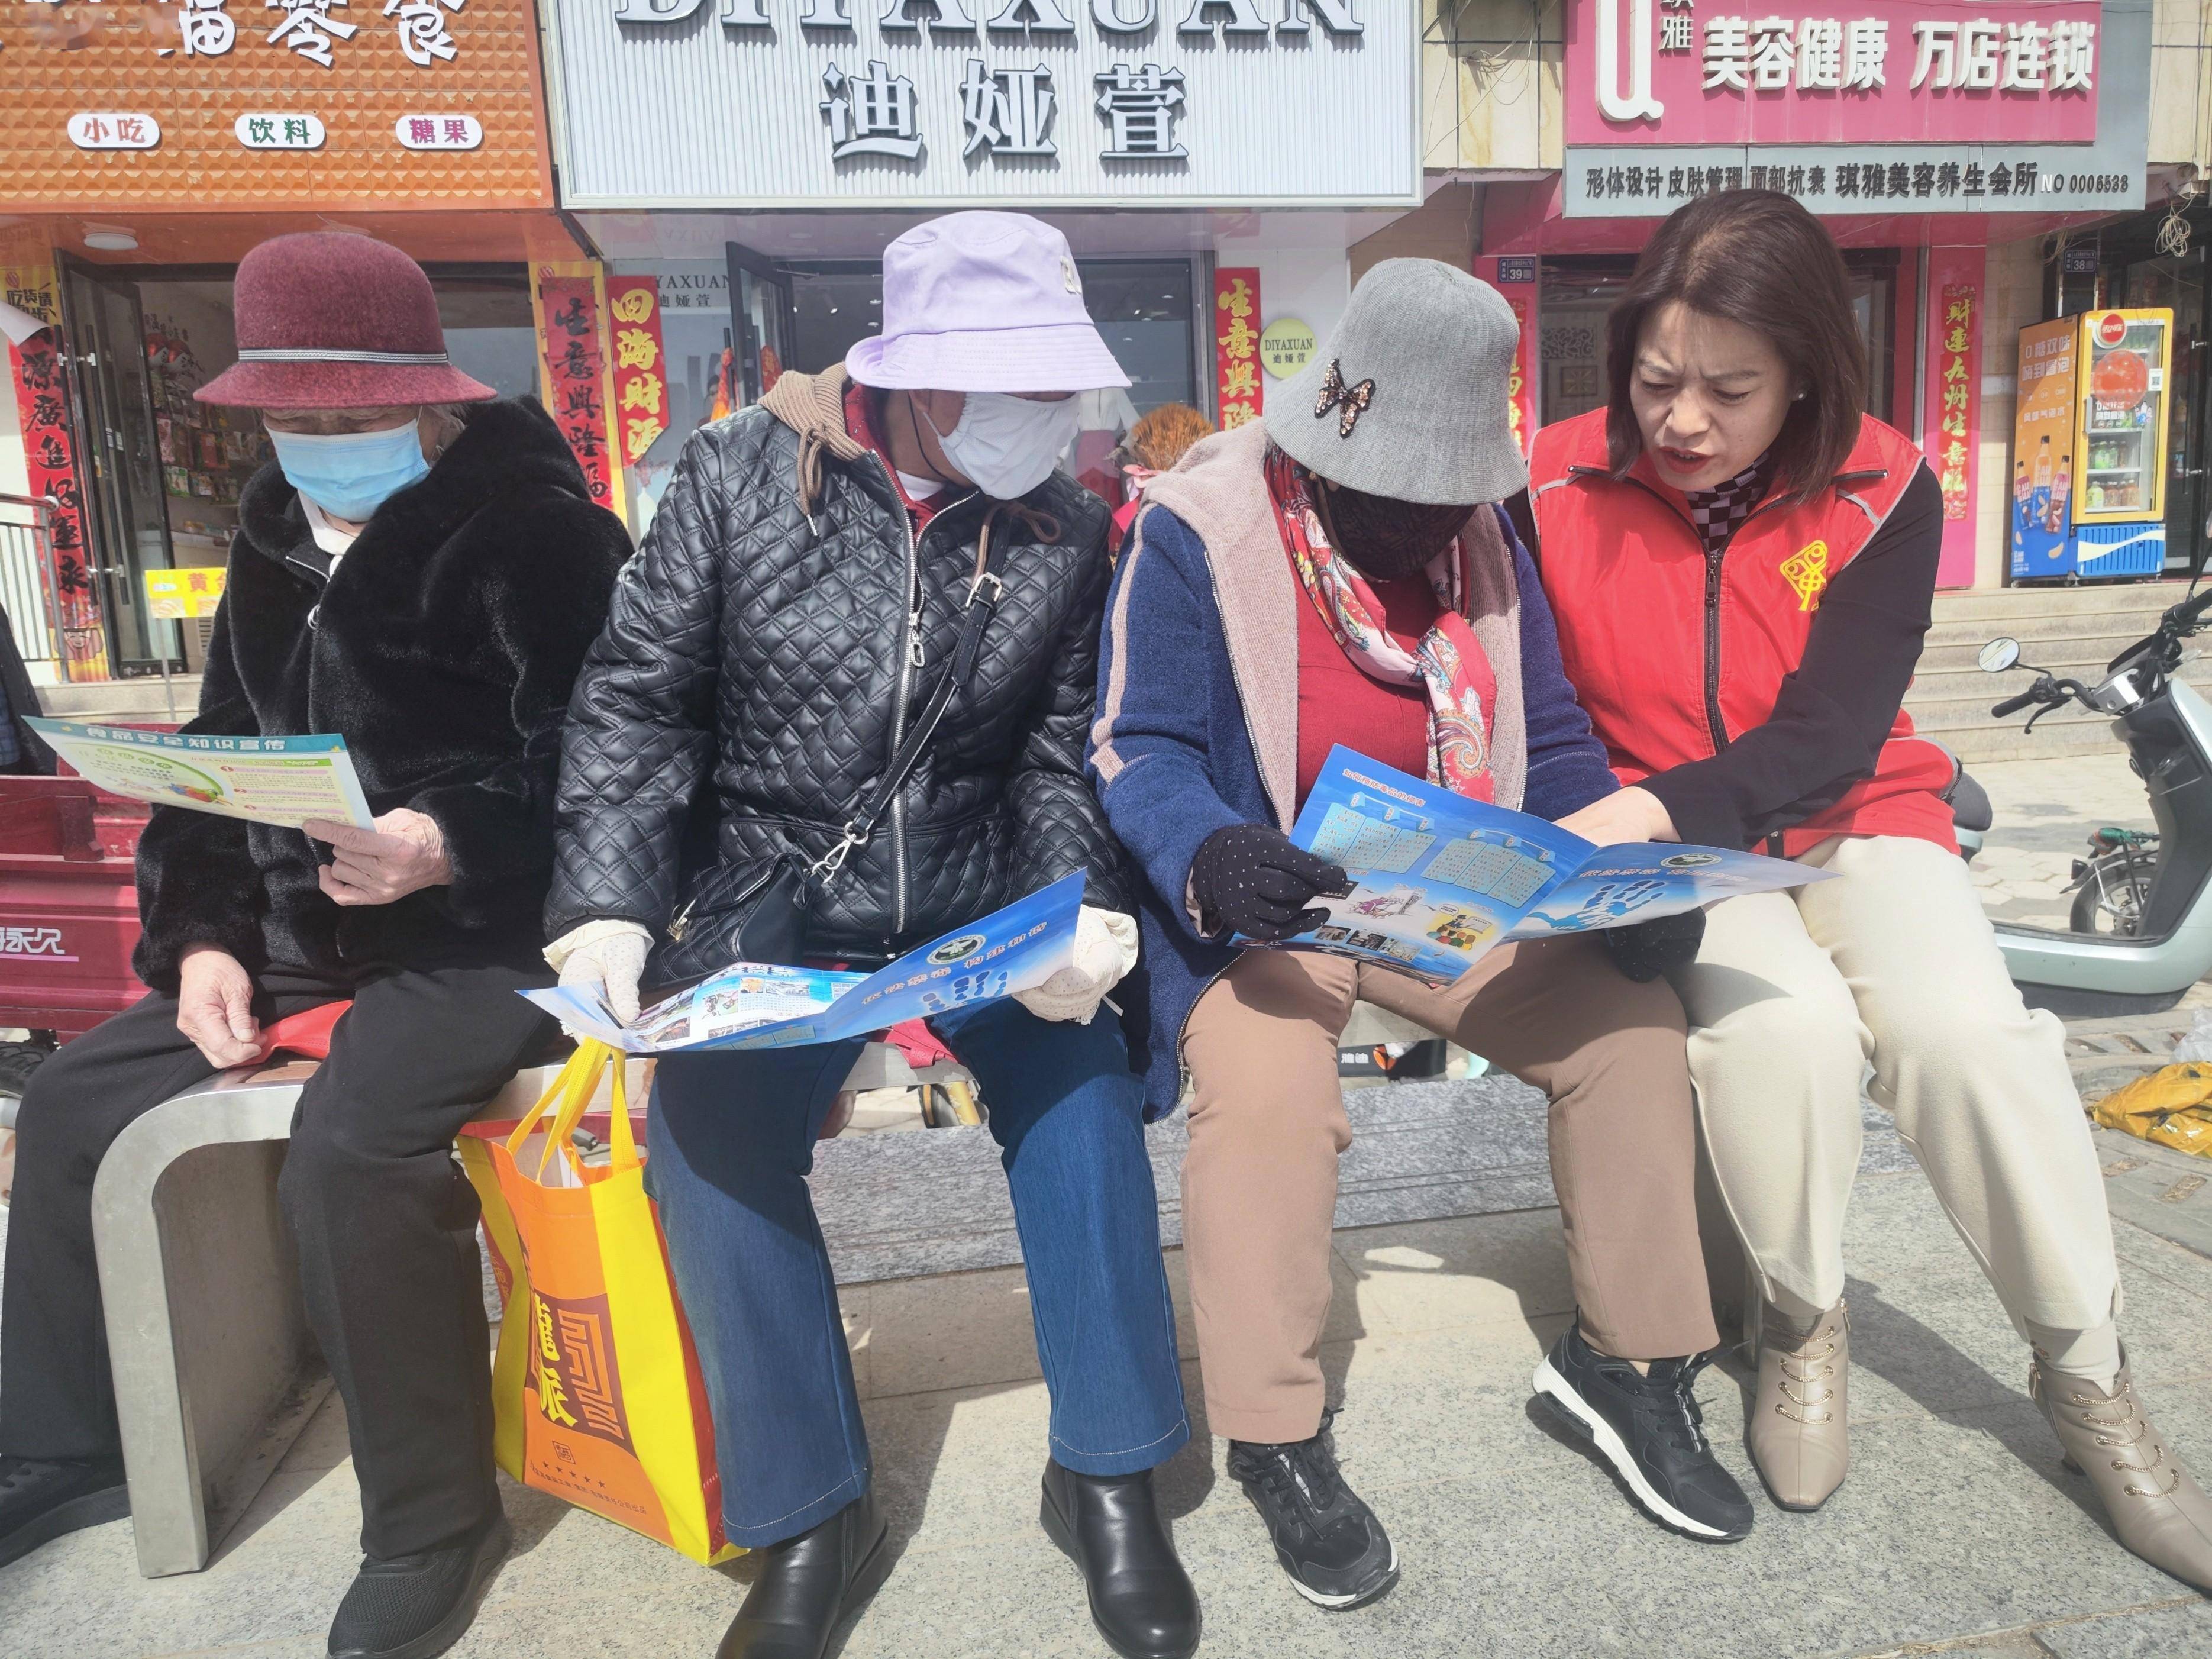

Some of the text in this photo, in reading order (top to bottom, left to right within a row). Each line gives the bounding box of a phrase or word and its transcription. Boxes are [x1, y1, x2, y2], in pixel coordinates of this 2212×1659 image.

[1701, 16, 2095, 92] 美容健康 万店连锁
[821, 59, 1189, 161] 迪娅萱
[83, 118, 146, 144] 小吃
[249, 118, 311, 144] 饮料
[409, 118, 469, 144] 糖果
[1585, 166, 1664, 199] 形体设计
[1835, 162, 2039, 198] 琪雅美容养生会所
[2041, 173, 2064, 193] NO
[1509, 269, 1522, 280] 39
[2074, 260, 2085, 270] 38
[1264, 338, 1313, 351] DIYAXUAN
[1273, 353, 1306, 364] 迪娅萱
[87, 727, 285, 750] 食品安全知识宣传
